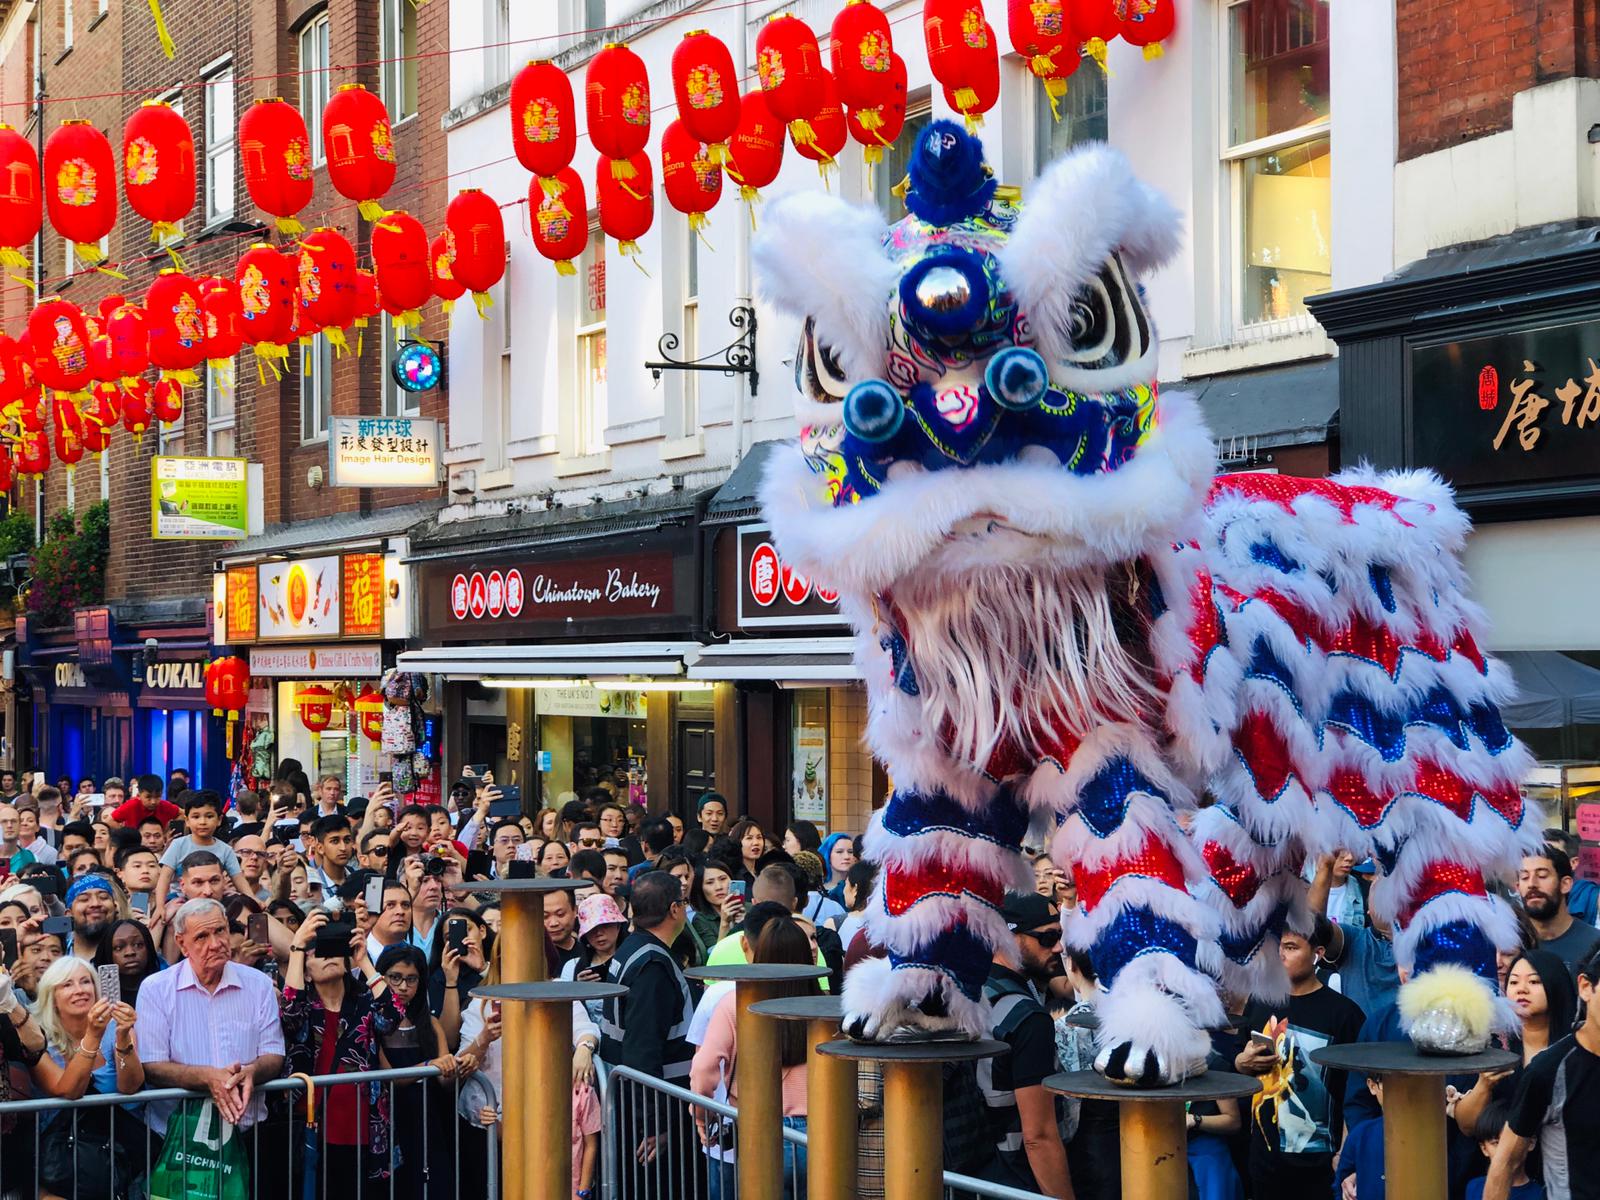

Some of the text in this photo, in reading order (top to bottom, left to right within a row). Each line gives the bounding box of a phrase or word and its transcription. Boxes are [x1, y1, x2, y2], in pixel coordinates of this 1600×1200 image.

[358, 418, 414, 438] 新环球
[341, 454, 431, 466] Image Hair Design
[532, 567, 661, 608] Chinatown Bakery
